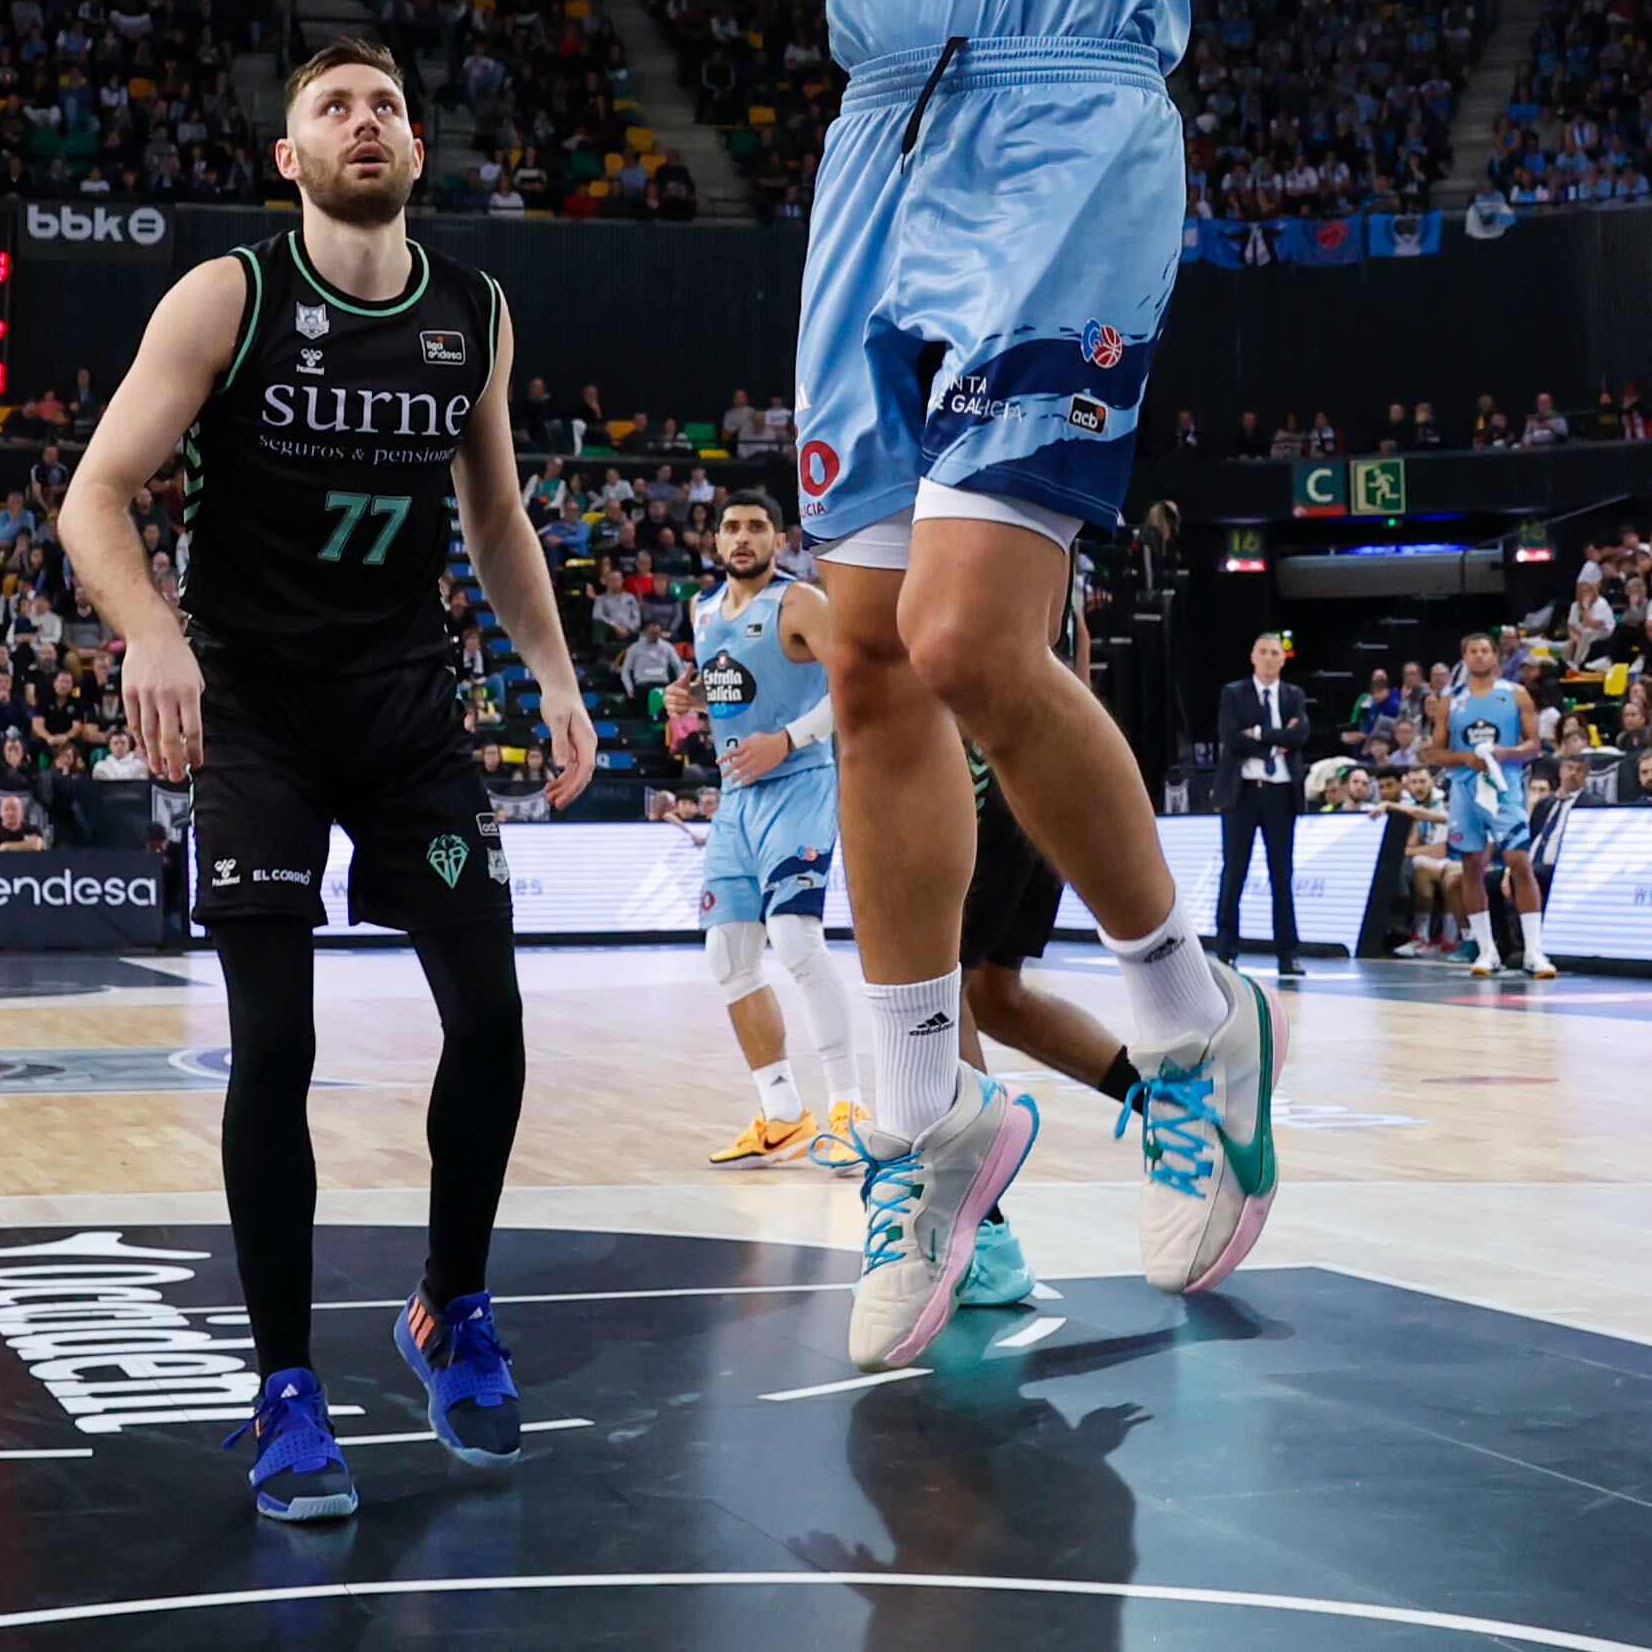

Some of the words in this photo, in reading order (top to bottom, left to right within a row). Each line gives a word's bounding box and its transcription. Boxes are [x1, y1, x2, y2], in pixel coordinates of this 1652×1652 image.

[25, 203, 123, 239] bbk
[261, 383, 471, 437] surne
[951, 396, 1025, 423] GALICIA
[1072, 409, 1099, 428] acb
[259, 433, 345, 461] seguros
[352, 448, 365, 461] &
[1306, 468, 1334, 503] C
[316, 489, 414, 565] 77
[703, 668, 743, 687] Estrella
[253, 869, 270, 882] EL
